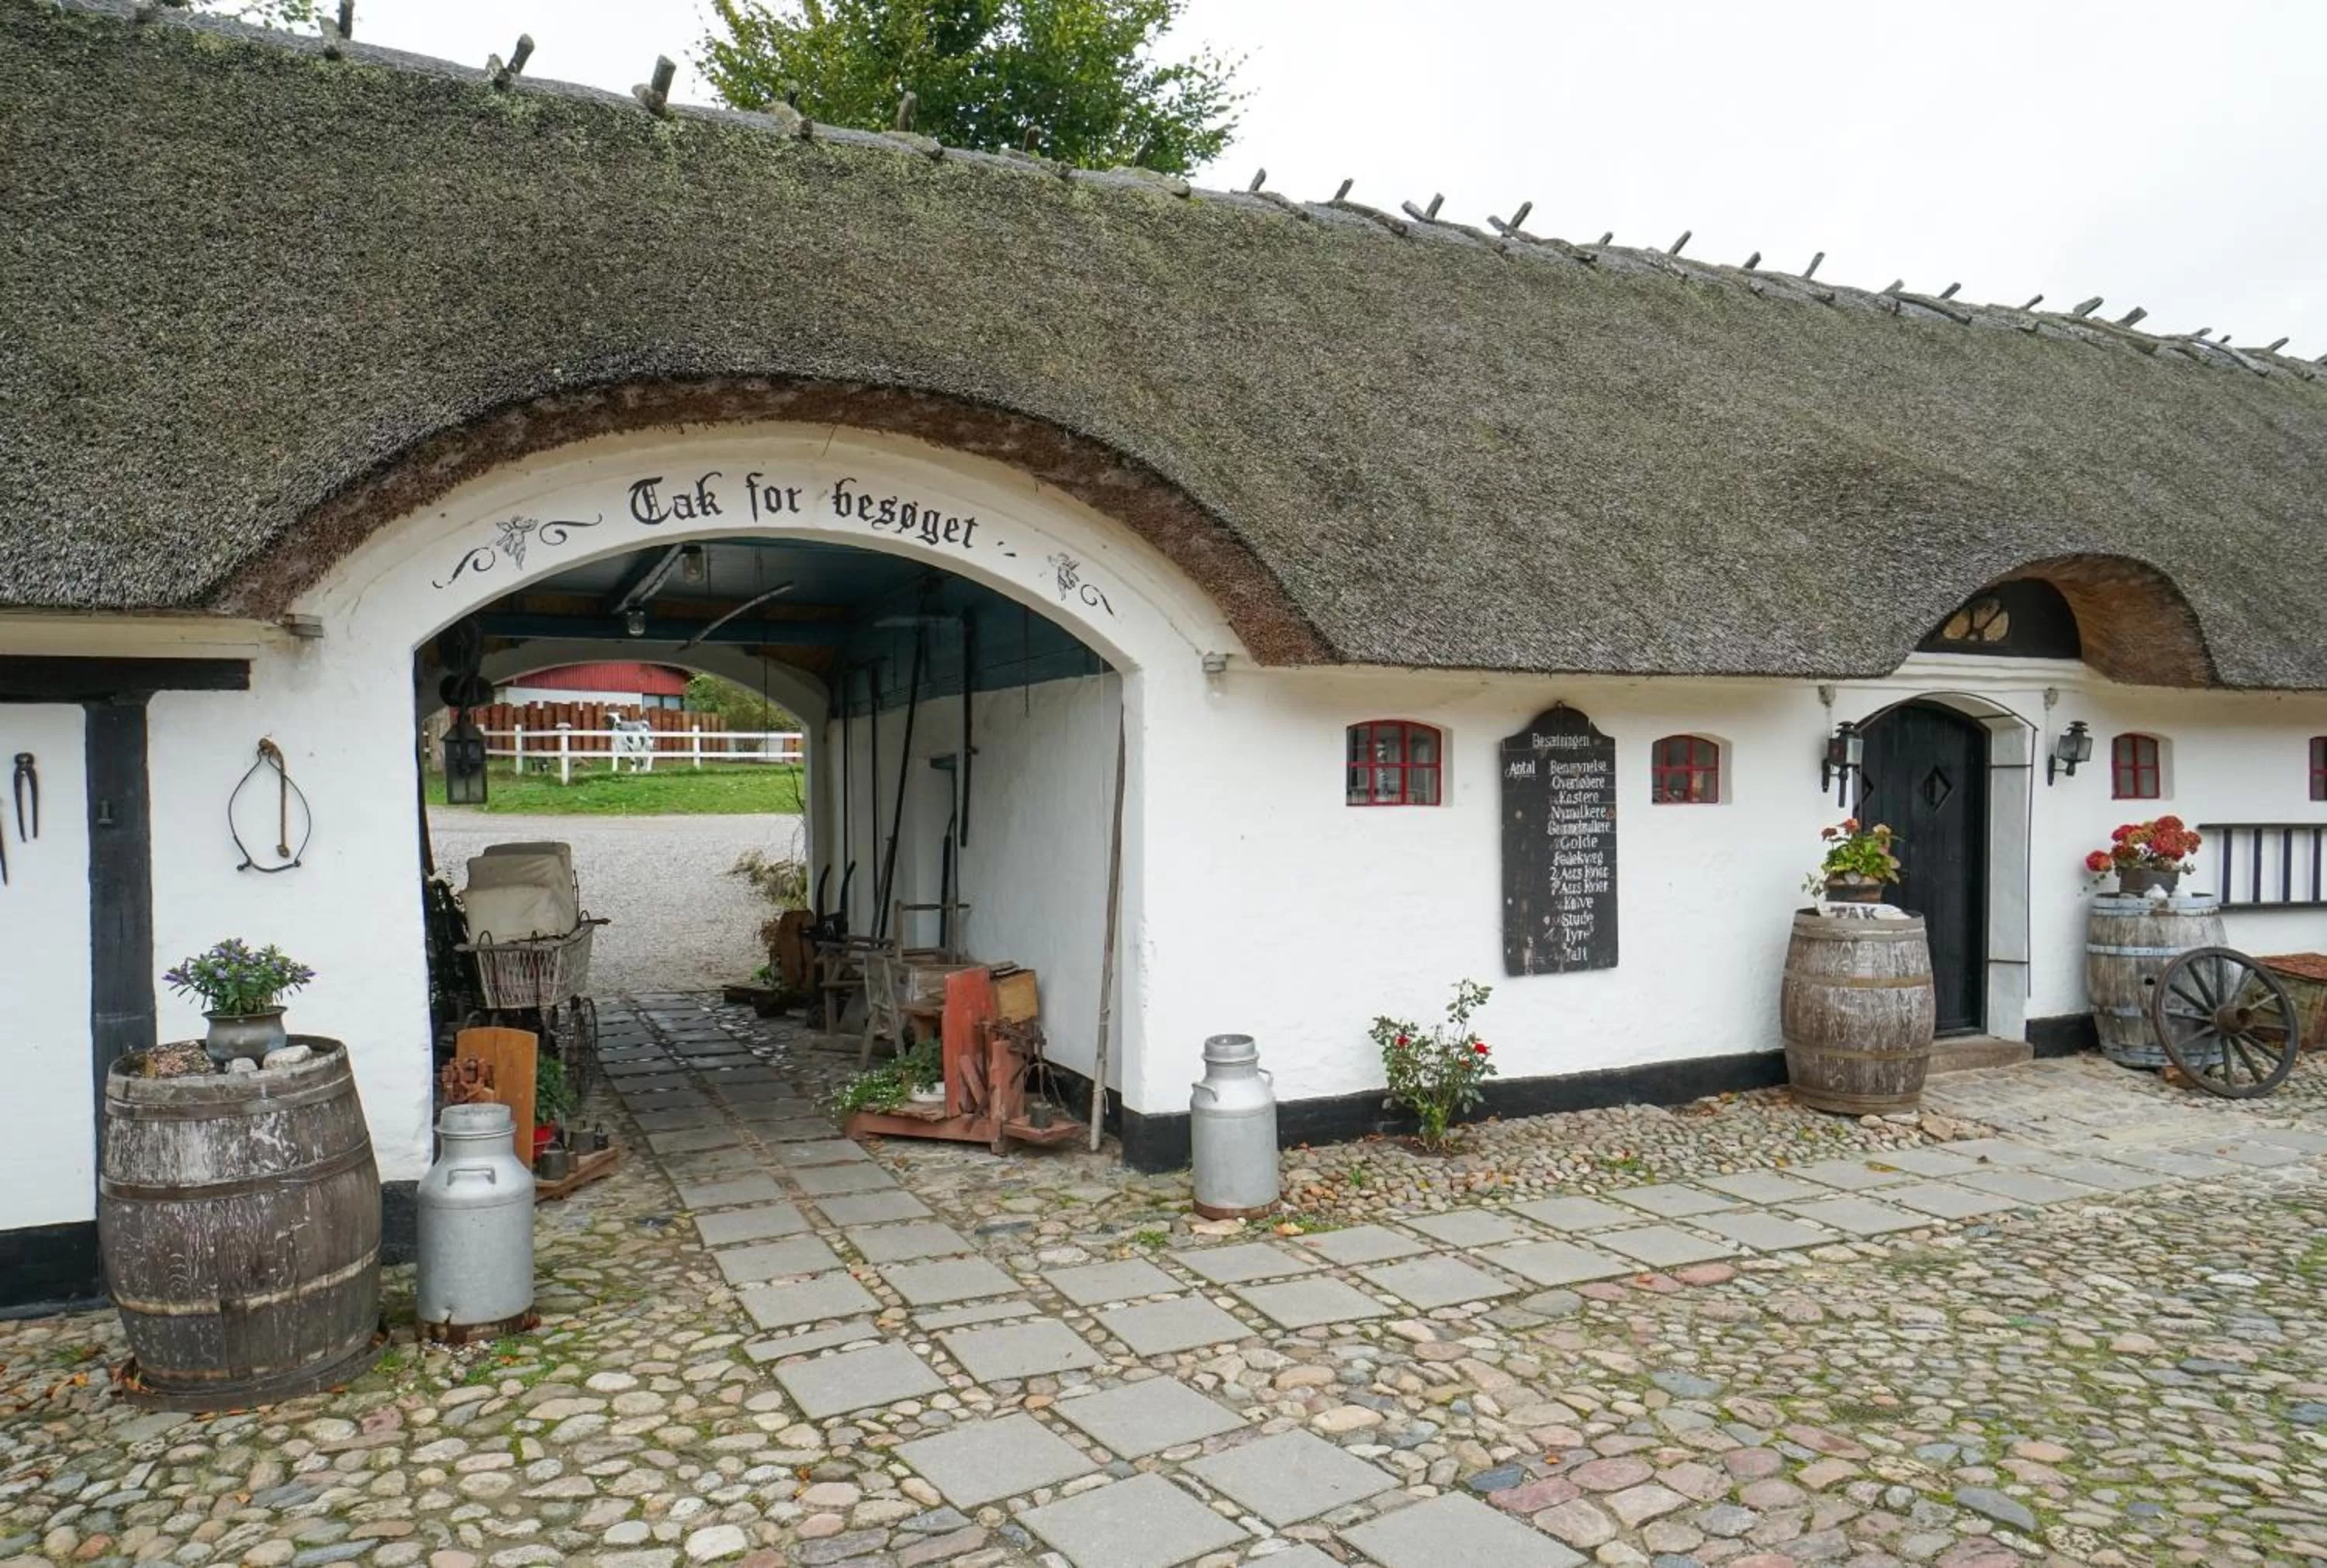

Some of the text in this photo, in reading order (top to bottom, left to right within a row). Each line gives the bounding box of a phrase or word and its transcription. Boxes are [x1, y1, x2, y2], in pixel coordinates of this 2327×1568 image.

[628, 471, 979, 548] Tak for besøget
[1559, 834, 1598, 851] Golde
[1830, 906, 1879, 920] TAK
